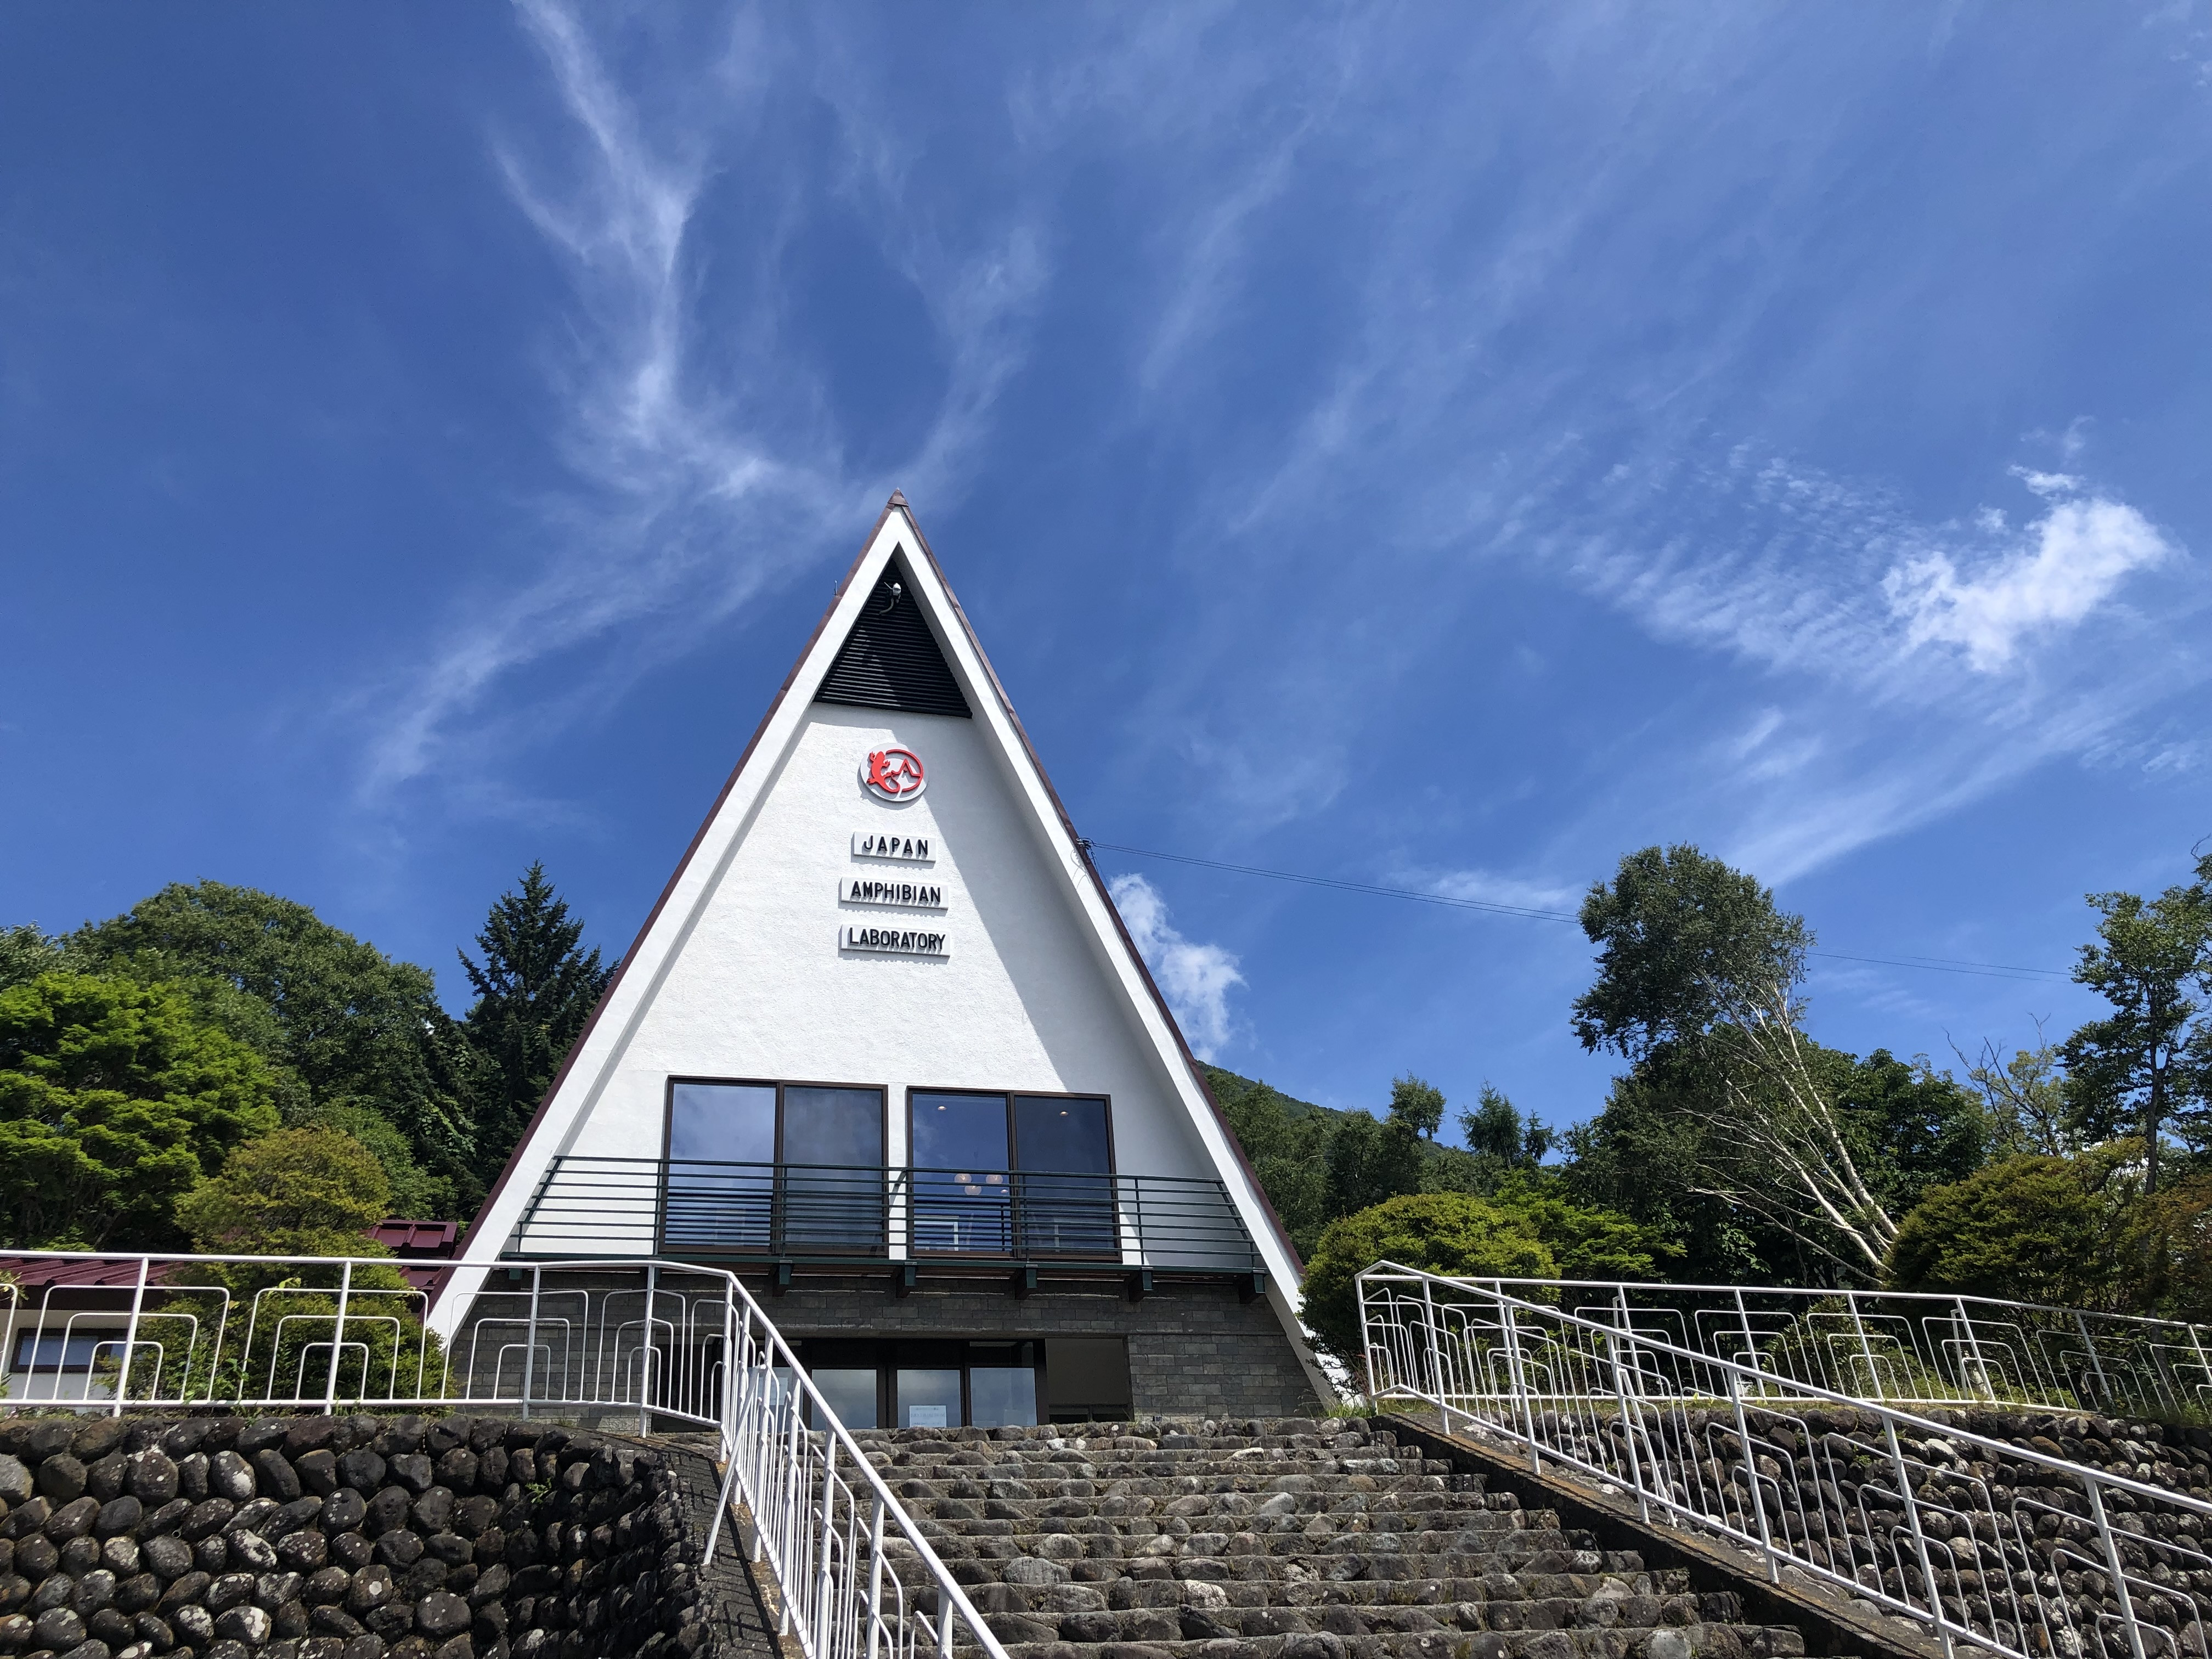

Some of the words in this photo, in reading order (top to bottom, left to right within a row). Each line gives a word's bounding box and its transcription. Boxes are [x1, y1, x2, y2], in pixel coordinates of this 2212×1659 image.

[864, 836, 928, 855] JAPAN
[851, 881, 940, 902] AMPHIBIAN
[849, 927, 945, 950] LABORATORY
